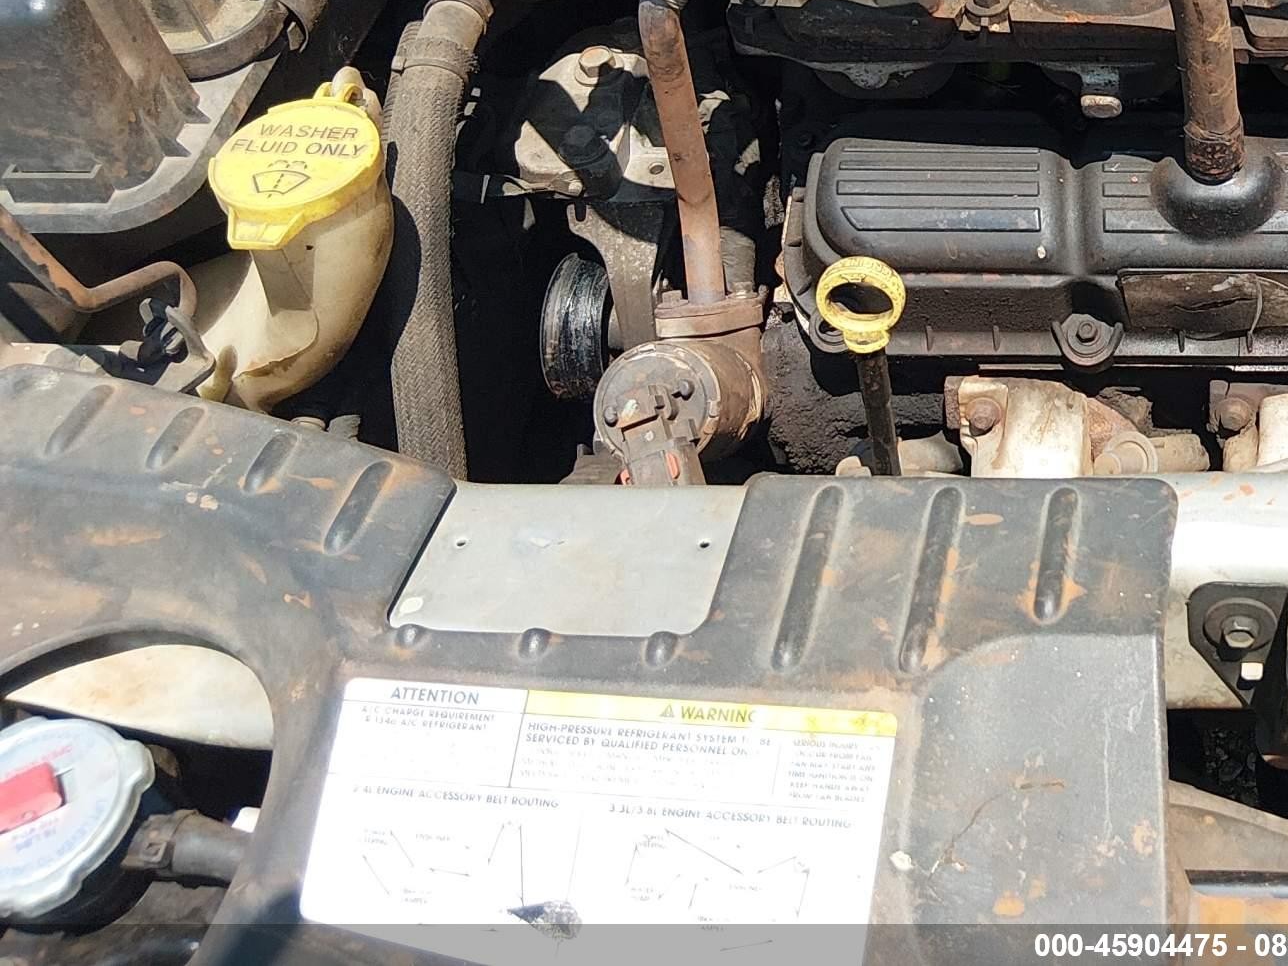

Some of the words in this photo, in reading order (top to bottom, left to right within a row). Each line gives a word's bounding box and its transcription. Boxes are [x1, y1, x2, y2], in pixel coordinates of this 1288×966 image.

[260, 123, 359, 140] WASHER
[230, 138, 298, 154] FLUID
[305, 142, 367, 157] ONLY
[391, 686, 480, 705] ATTENTION
[429, 709, 495, 722] REQUIREMENT
[422, 720, 488, 731] REFRIGERANT
[528, 721, 613, 736] HIGH-PRESSURE
[617, 727, 691, 741] REFRIGERANT
[526, 732, 579, 746] SERVICED
[584, 737, 596, 746] BY
[601, 738, 658, 751] QUALIFIED
[662, 741, 726, 755] PERSONNEL
[376, 785, 415, 798] ENGINE
[418, 787, 482, 803] ACCESSORY
[486, 794, 508, 805] BELT
[511, 797, 559, 809] ROUTING
[662, 808, 701, 819] ENGINE
[706, 809, 771, 823] ACCESSORY
[802, 817, 851, 829] ROUTING
